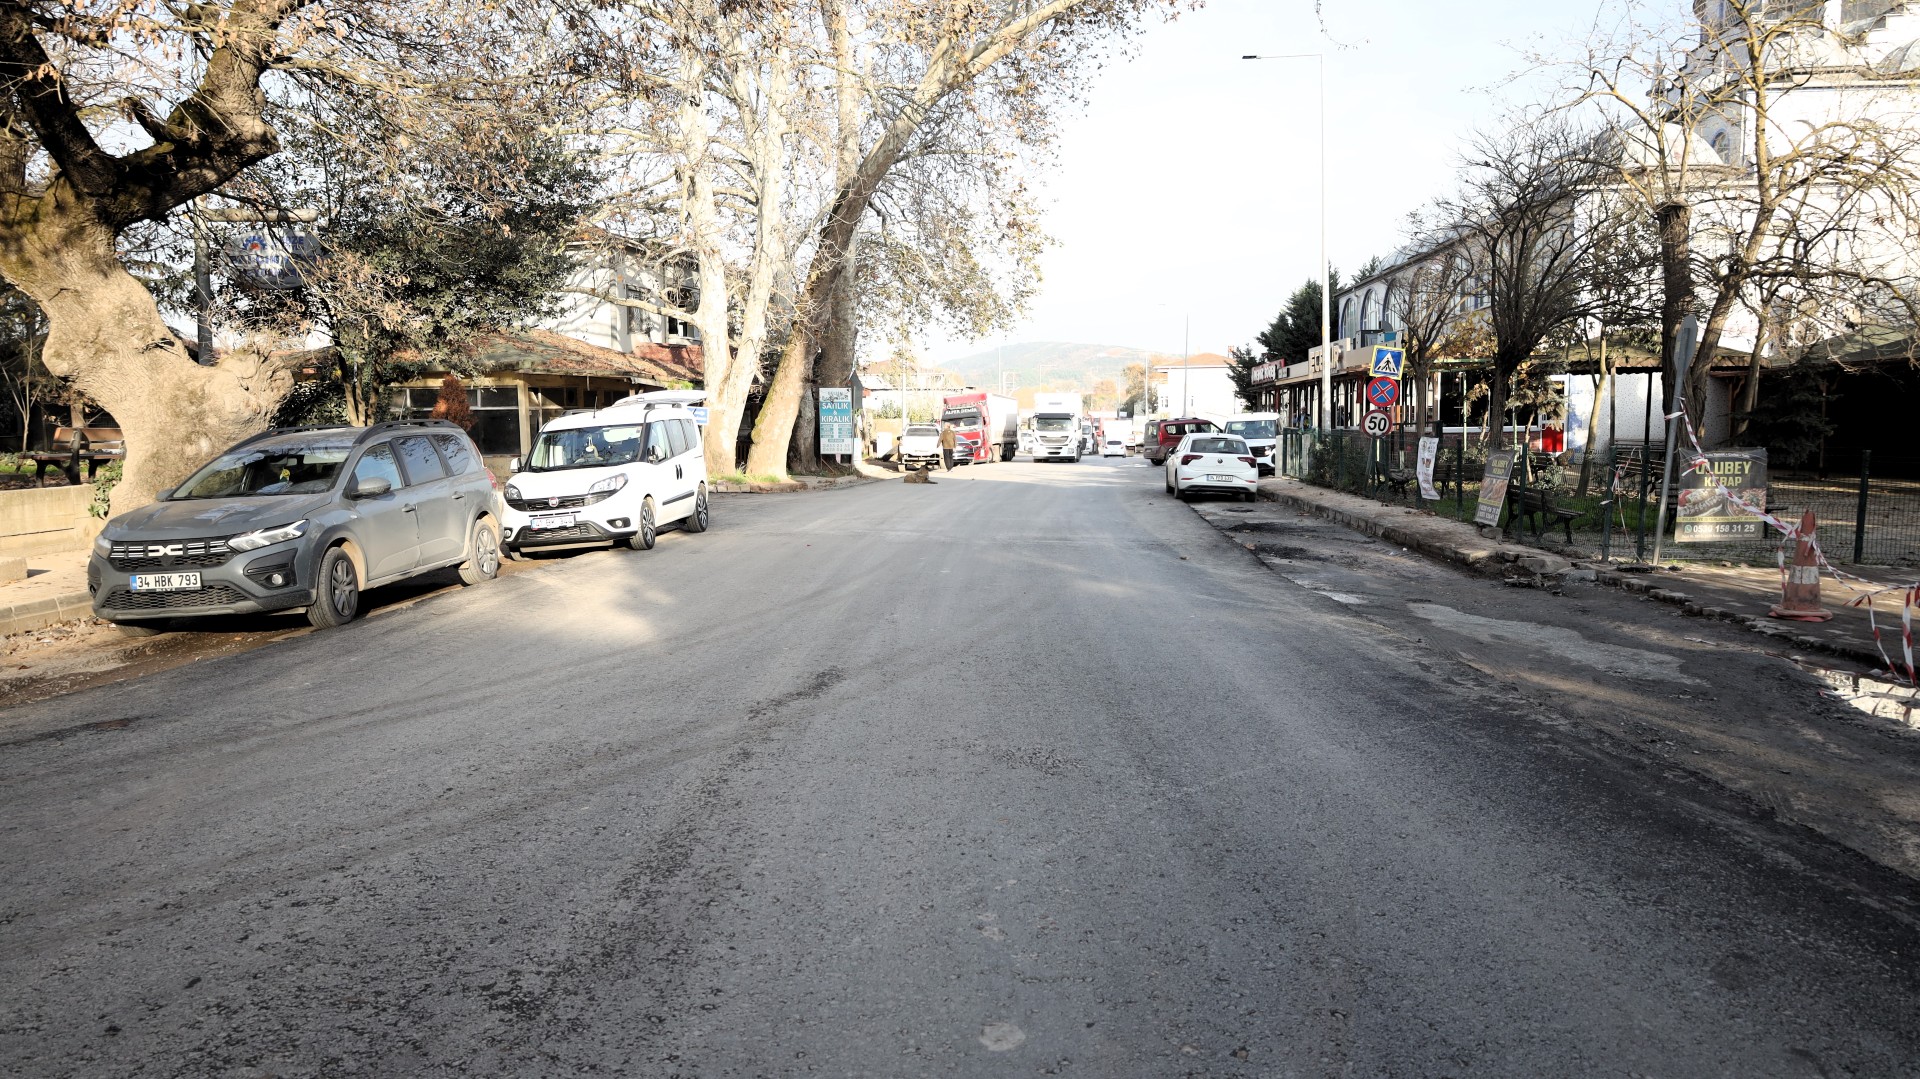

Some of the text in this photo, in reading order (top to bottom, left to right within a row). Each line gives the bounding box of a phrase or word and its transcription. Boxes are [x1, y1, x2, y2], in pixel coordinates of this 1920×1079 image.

[821, 402, 849, 410] SATILIK
[1368, 415, 1387, 432] 50
[1744, 524, 1755, 532] 25
[137, 574, 198, 588] 34 HBK 793
